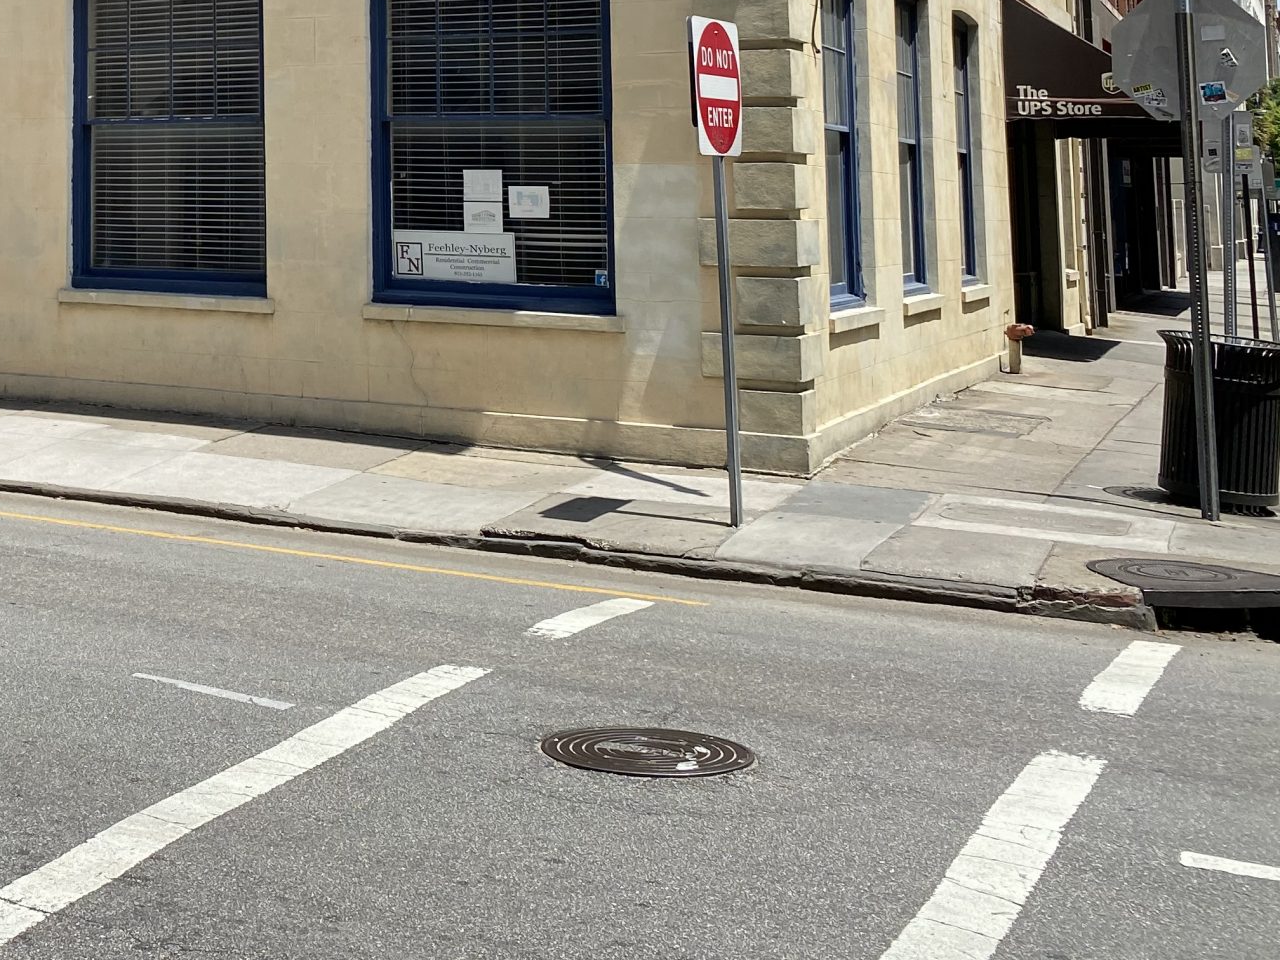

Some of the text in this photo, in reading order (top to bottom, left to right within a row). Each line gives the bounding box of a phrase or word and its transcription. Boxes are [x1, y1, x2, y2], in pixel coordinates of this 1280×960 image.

[701, 46, 733, 70] DO NOT
[1016, 85, 1048, 99] The
[1017, 101, 1102, 115] UPS Store
[707, 106, 733, 128] ENTER
[399, 245, 410, 259] F
[428, 243, 507, 256] Feehley-Nyberg
[407, 257, 421, 273] N
